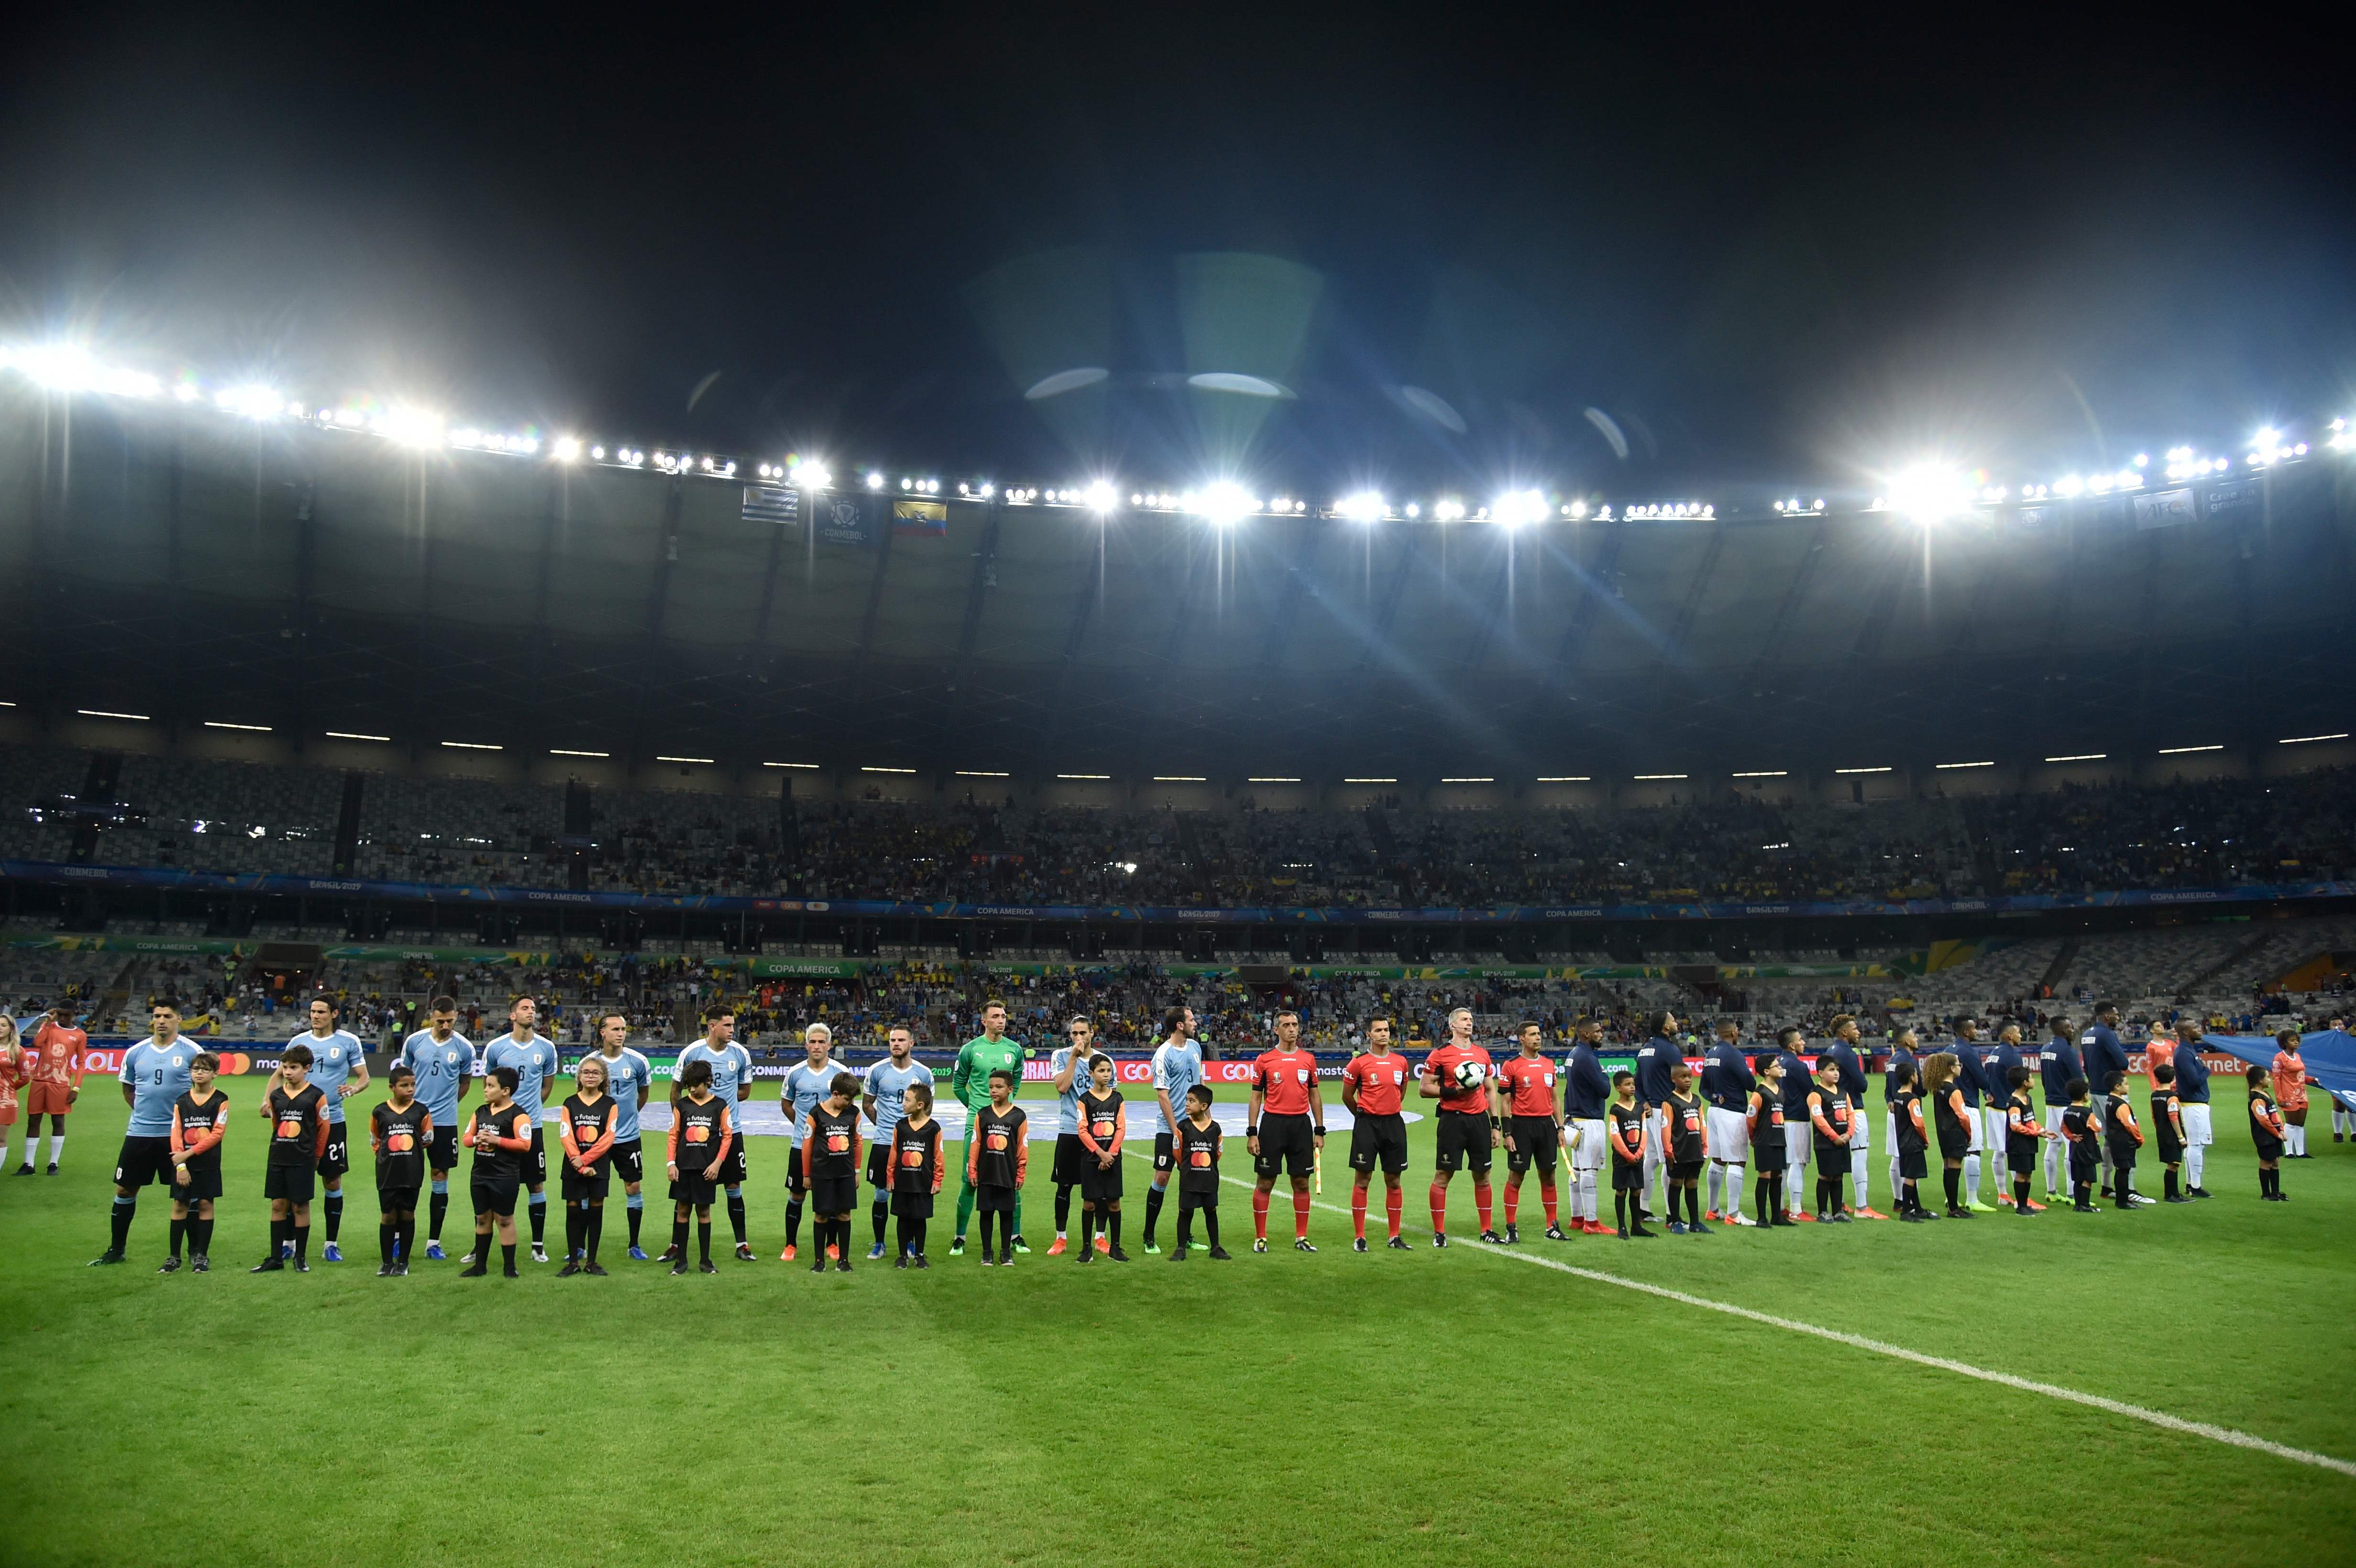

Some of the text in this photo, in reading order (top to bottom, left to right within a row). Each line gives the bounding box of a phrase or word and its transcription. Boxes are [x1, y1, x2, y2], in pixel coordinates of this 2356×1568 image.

[825, 528, 863, 540] CONMEBOL
[65, 867, 109, 878] CONMEBOL
[553, 893, 591, 902] AMERICA
[769, 965, 840, 974] COPA AMERICA
[431, 1060, 440, 1077] 5
[518, 1065, 525, 1081] 6
[932, 1067, 951, 1076] 2019
[1187, 1068, 1193, 1083] 3
[154, 1068, 163, 1085] 9
[713, 1072, 722, 1088] 2
[1077, 1074, 1090, 1089] 22
[897, 1089, 904, 1104] 8
[328, 1141, 345, 1161] 21
[452, 1138, 458, 1154] 5
[538, 1152, 545, 1168] 6
[738, 1151, 746, 1168] 2
